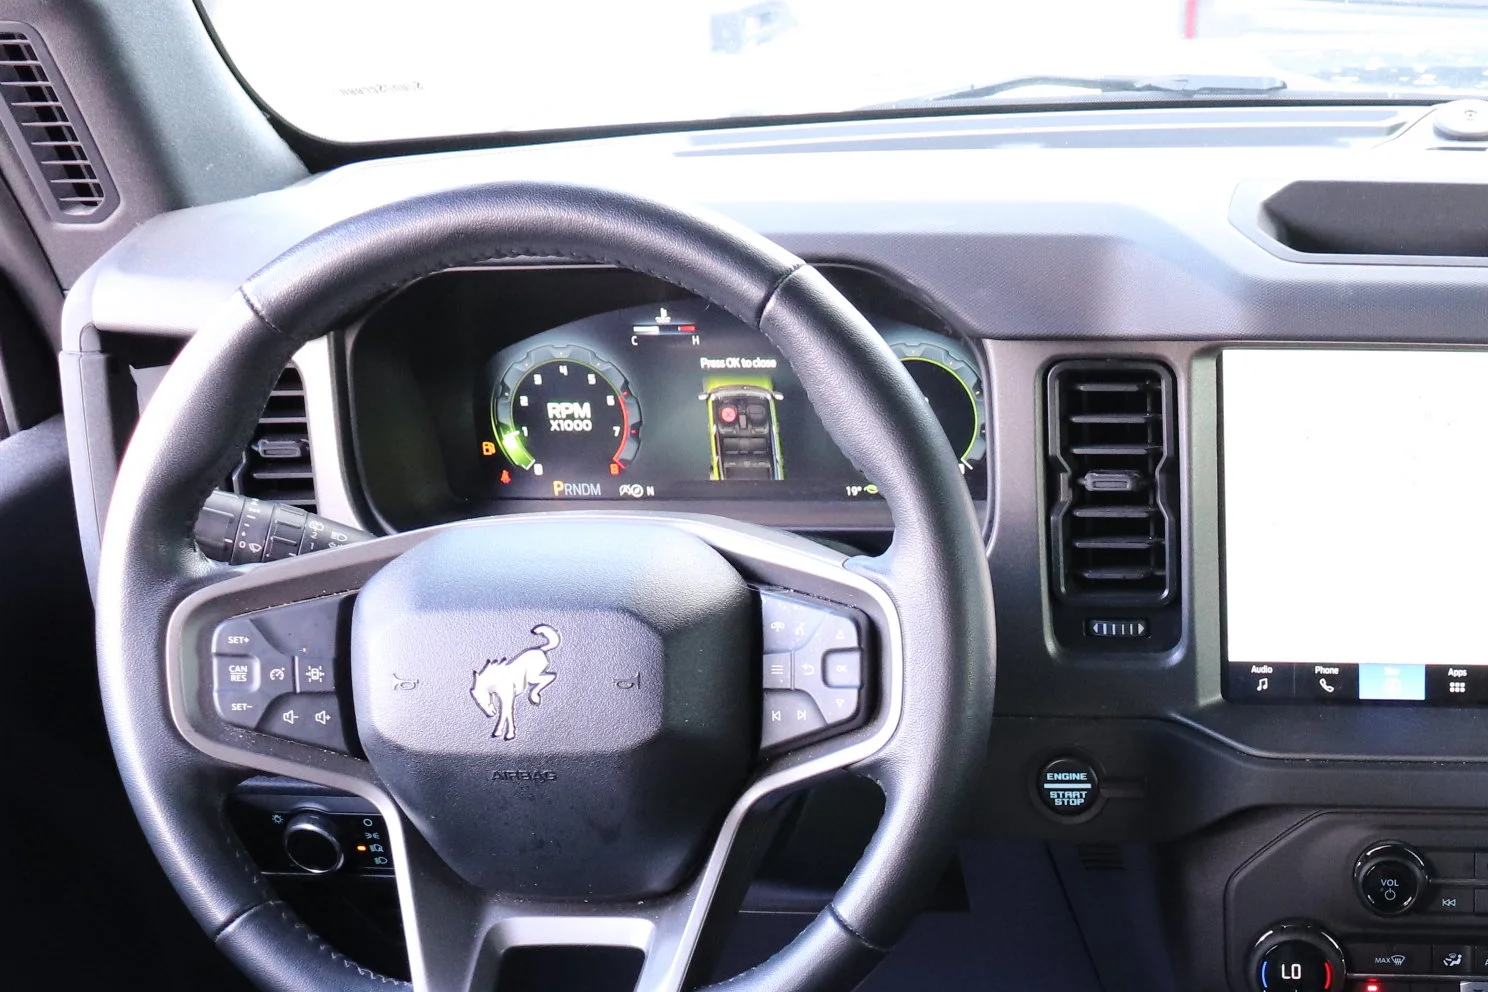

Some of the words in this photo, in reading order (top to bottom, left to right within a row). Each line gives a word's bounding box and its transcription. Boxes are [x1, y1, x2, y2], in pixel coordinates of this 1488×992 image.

[630, 335, 639, 346] C
[691, 335, 700, 346] H
[700, 357, 725, 369] Press
[725, 357, 741, 369] OK
[741, 357, 751, 369] to
[752, 357, 777, 369] close
[558, 364, 569, 376] 4
[533, 373, 543, 385] 3
[587, 373, 597, 385] 5
[519, 395, 529, 407] 2
[606, 395, 615, 406] 6
[546, 401, 592, 419] RPM
[549, 419, 593, 432] X1000
[521, 426, 529, 437] 1
[612, 426, 621, 437] 7
[533, 463, 544, 476] 0
[609, 463, 620, 475] 8
[553, 480, 601, 496] PRNDM
[646, 486, 655, 496] N
[228, 664, 248, 674] CAN
[1250, 664, 1274, 674] Audio
[1314, 665, 1340, 675] Phone
[1447, 668, 1468, 678] Apps
[230, 673, 248, 683] RES
[1046, 772, 1088, 781] ENGINE
[1049, 790, 1088, 799] START
[1054, 798, 1085, 806] STOP
[1380, 878, 1400, 887] VOL
[1374, 956, 1391, 964] MAX
[1281, 963, 1302, 980] LO
